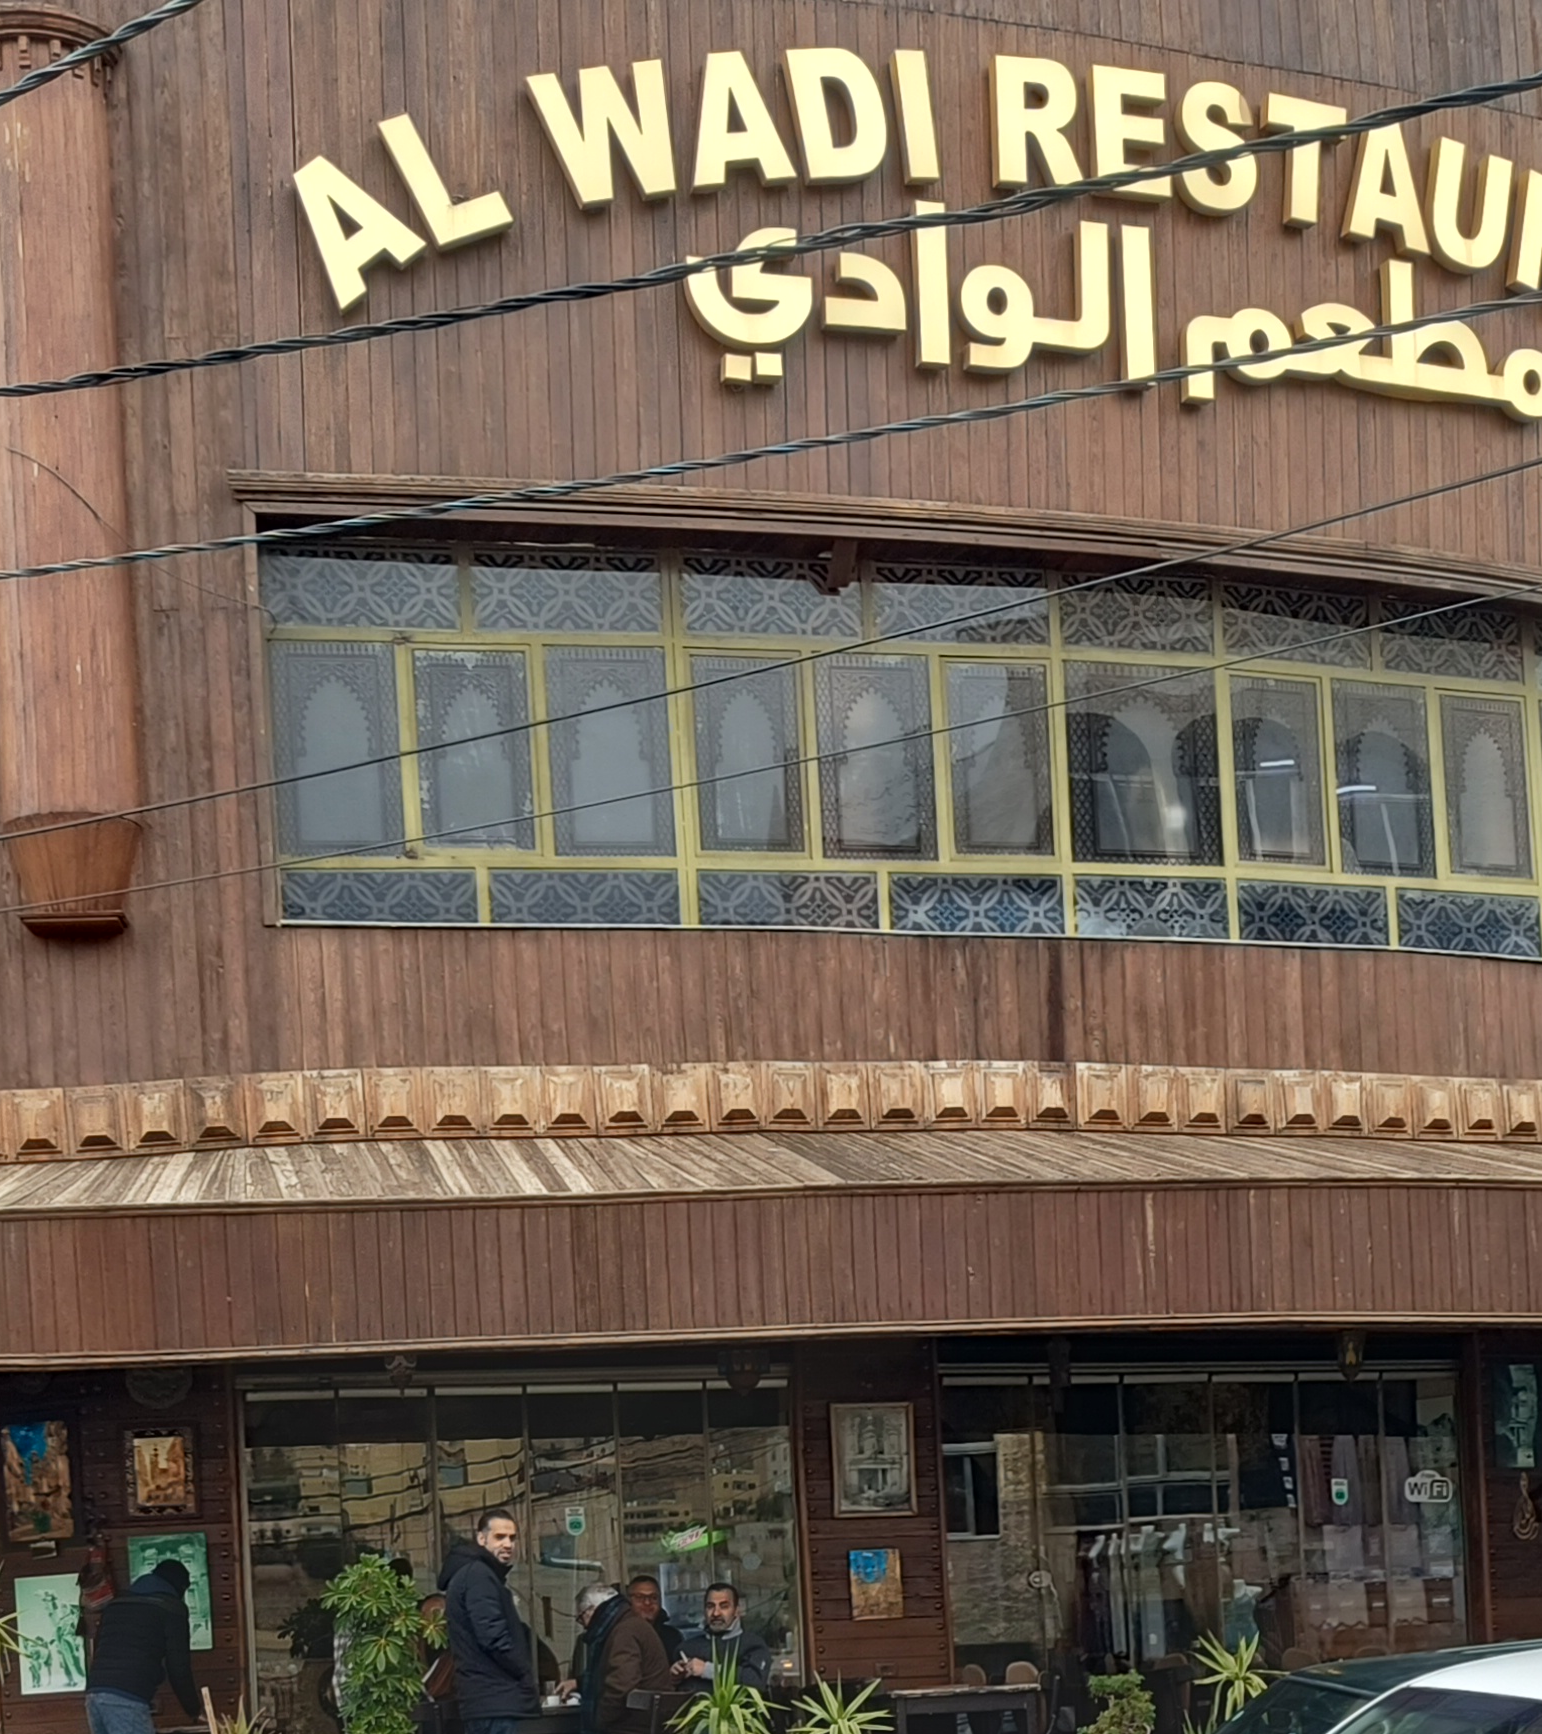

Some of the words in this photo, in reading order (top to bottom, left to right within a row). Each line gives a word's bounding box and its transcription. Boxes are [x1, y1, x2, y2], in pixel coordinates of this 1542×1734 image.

[292, 112, 514, 315] AL
[525, 46, 940, 211] WADI
[685, 200, 1156, 391] الوادي
